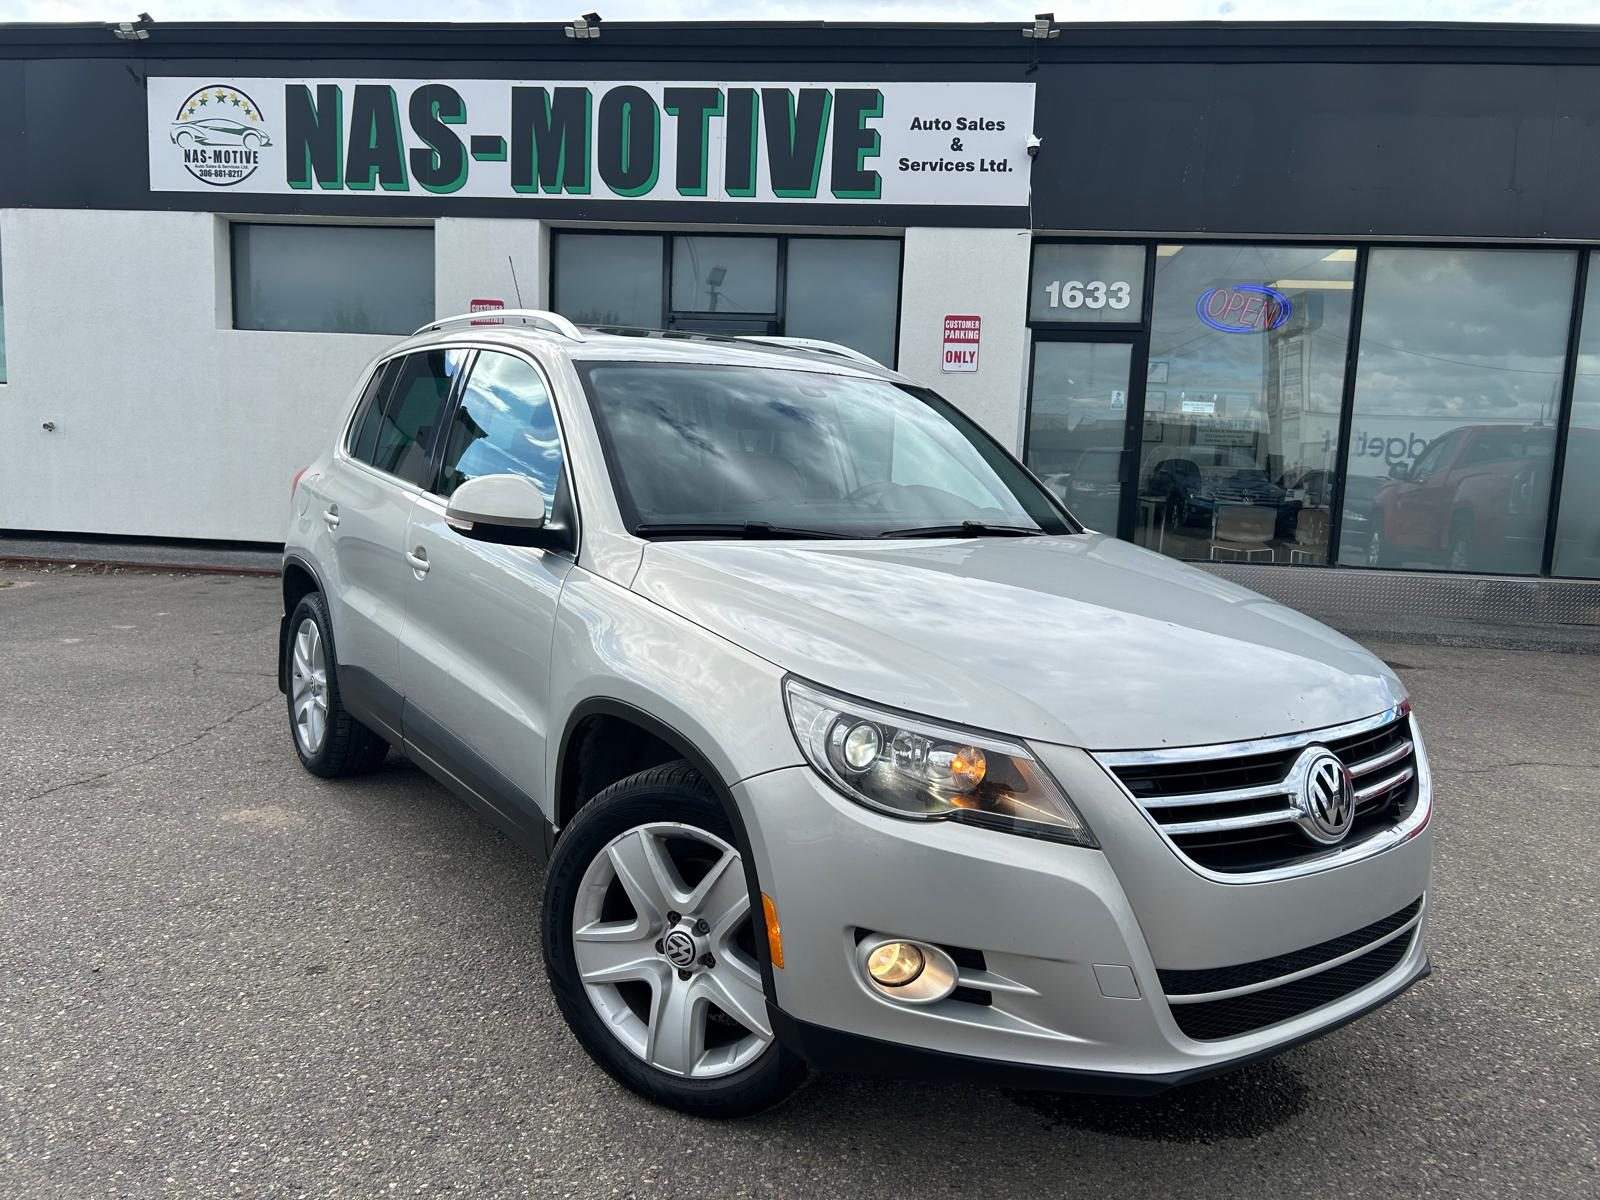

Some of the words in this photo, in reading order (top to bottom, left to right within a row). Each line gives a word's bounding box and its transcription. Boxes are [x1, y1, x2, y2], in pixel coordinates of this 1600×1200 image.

[910, 117, 952, 131] Auto
[956, 117, 1006, 131] Sales
[285, 83, 884, 199] NAS-MOTIVE
[950, 137, 963, 151] &
[184, 149, 258, 164] NAS-MOTIVE
[898, 158, 975, 172] Services
[980, 158, 1013, 172] Ltd.
[199, 169, 243, 178] 306-881-8217
[1045, 280, 1131, 309] 1633
[1208, 288, 1279, 329] OPEN
[945, 320, 979, 329] CUSTOMER
[945, 329, 979, 340] PARKING
[945, 350, 976, 364] ONLY
